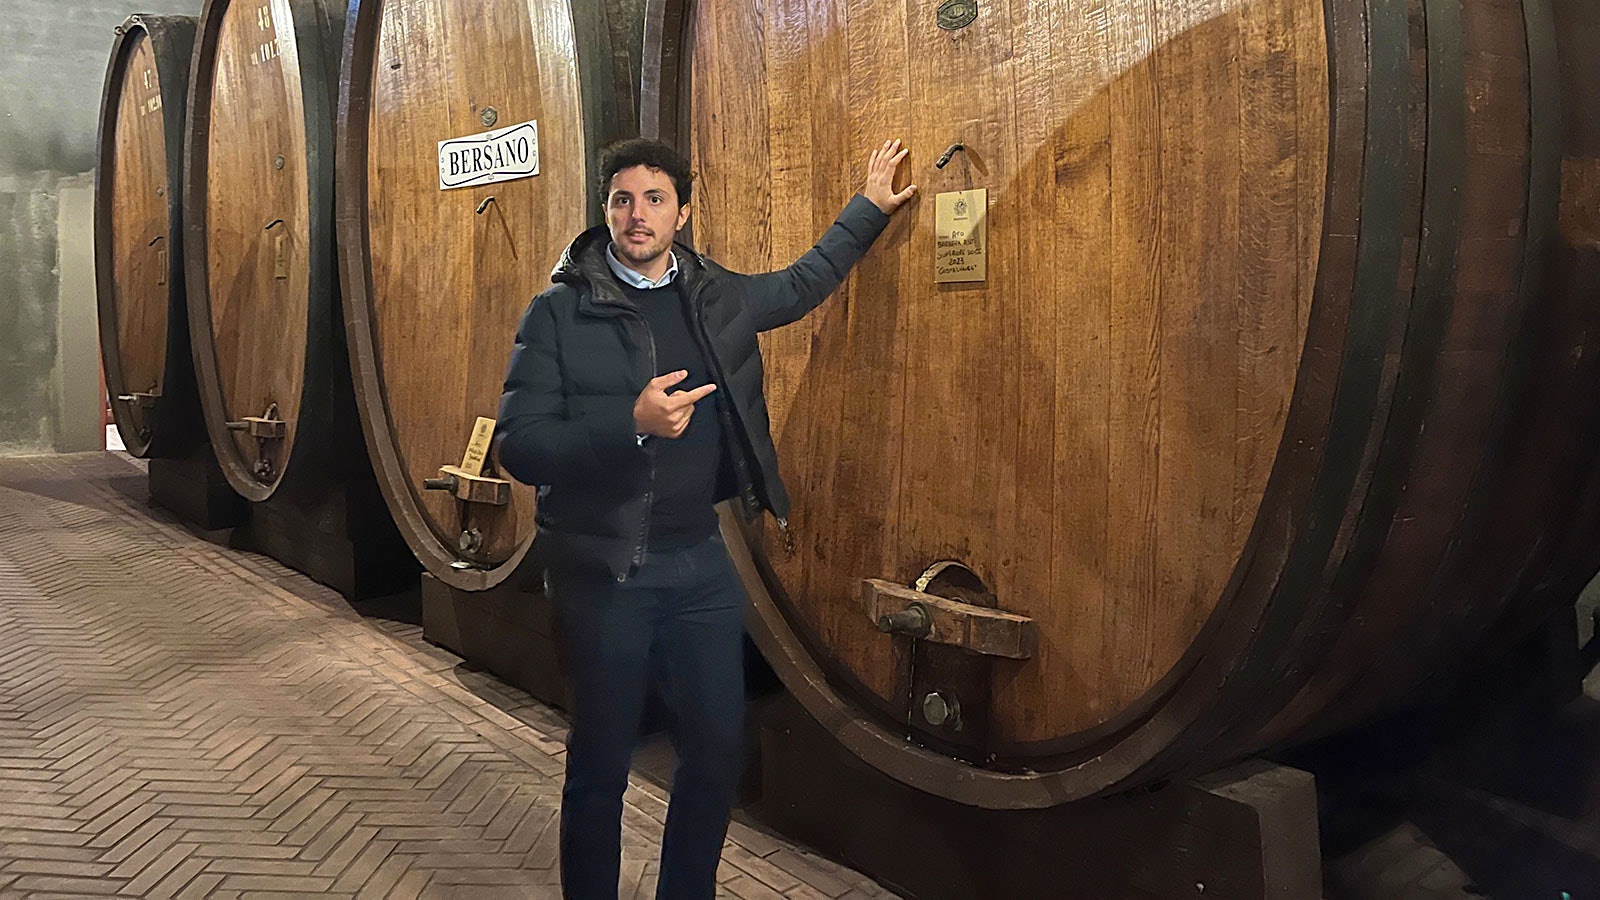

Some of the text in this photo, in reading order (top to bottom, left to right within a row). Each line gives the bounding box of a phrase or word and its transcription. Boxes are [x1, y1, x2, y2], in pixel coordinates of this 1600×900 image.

[257, 5, 270, 31] 48
[449, 136, 529, 176] BERSANO
[948, 257, 965, 266] 2023
